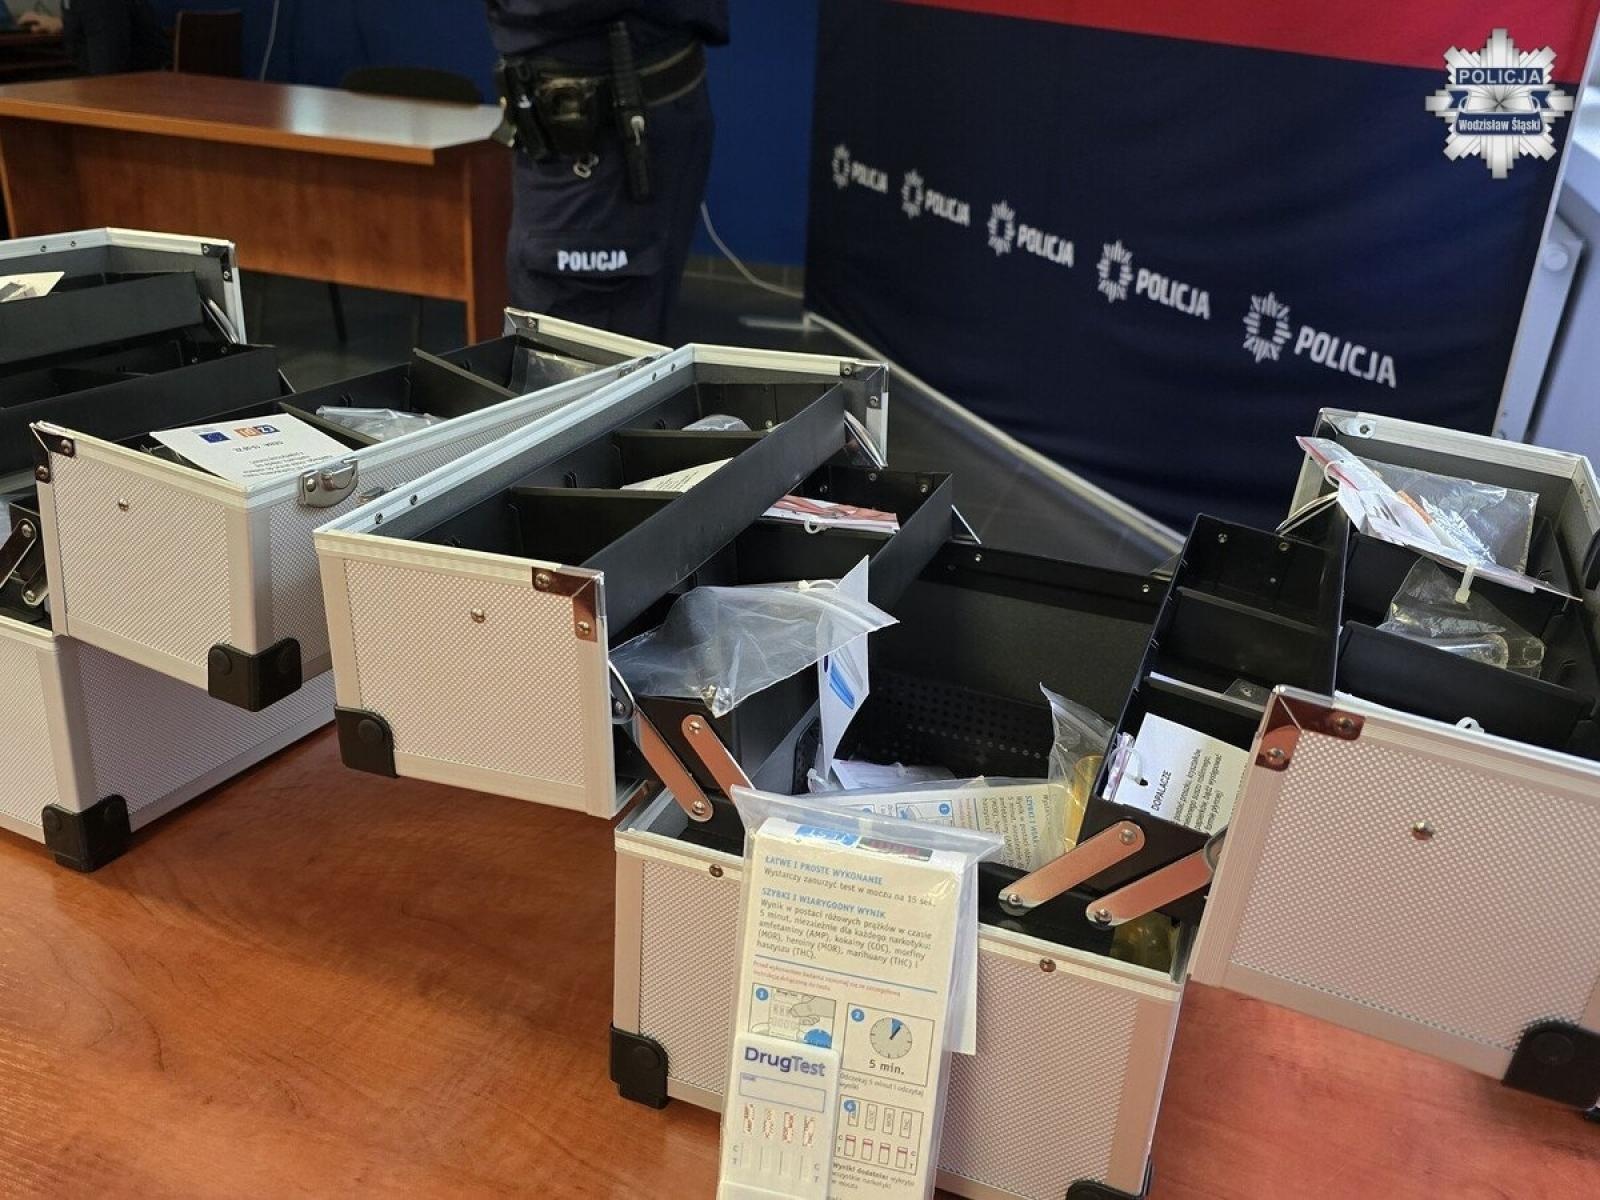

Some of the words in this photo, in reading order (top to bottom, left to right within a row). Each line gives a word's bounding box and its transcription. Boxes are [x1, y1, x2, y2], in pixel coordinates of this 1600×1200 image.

[851, 161, 888, 194] POLICJA
[924, 188, 970, 226] POLICJA
[557, 250, 629, 271] POLICJA
[1016, 223, 1075, 268] POLICJA
[1135, 268, 1211, 320] POLICJA
[1294, 325, 1397, 388] POLICJA
[1151, 769, 1172, 811] DOPALACZE
[764, 867, 801, 882] Wystarczy
[803, 875, 837, 889] zanurzyć
[839, 883, 854, 891] test
[907, 895, 917, 903] 15
[765, 854, 791, 867] ŁATWE
[799, 862, 829, 875] PROSTE
[832, 868, 882, 885] WYKONANIE
[760, 899, 783, 912] Wynik
[794, 905, 822, 920] postaci
[824, 911, 861, 927] różowych
[863, 919, 896, 934] prążków
[907, 928, 931, 939] czasie
[761, 887, 791, 900] SZYBKI
[798, 895, 854, 913] WIARYGODNY
[856, 906, 886, 919] WYNIK
[758, 919, 803, 936] amfetaminy
[805, 928, 831, 941] (AMP),
[834, 934, 865, 948] kokainy
[766, 911, 792, 923] minut,
[794, 916, 837, 932] niezależnie
[839, 925, 852, 935] dla
[853, 927, 886, 943] każdego
[756, 939, 790, 955] haszyszu
[757, 929, 783, 942] (MOR),
[785, 935, 814, 949] heroiny
[889, 955, 913, 968] (THC)
[744, 1046, 826, 1077] DrugTest
[869, 1059, 877, 1069] 5
[880, 1062, 905, 1075] min.
